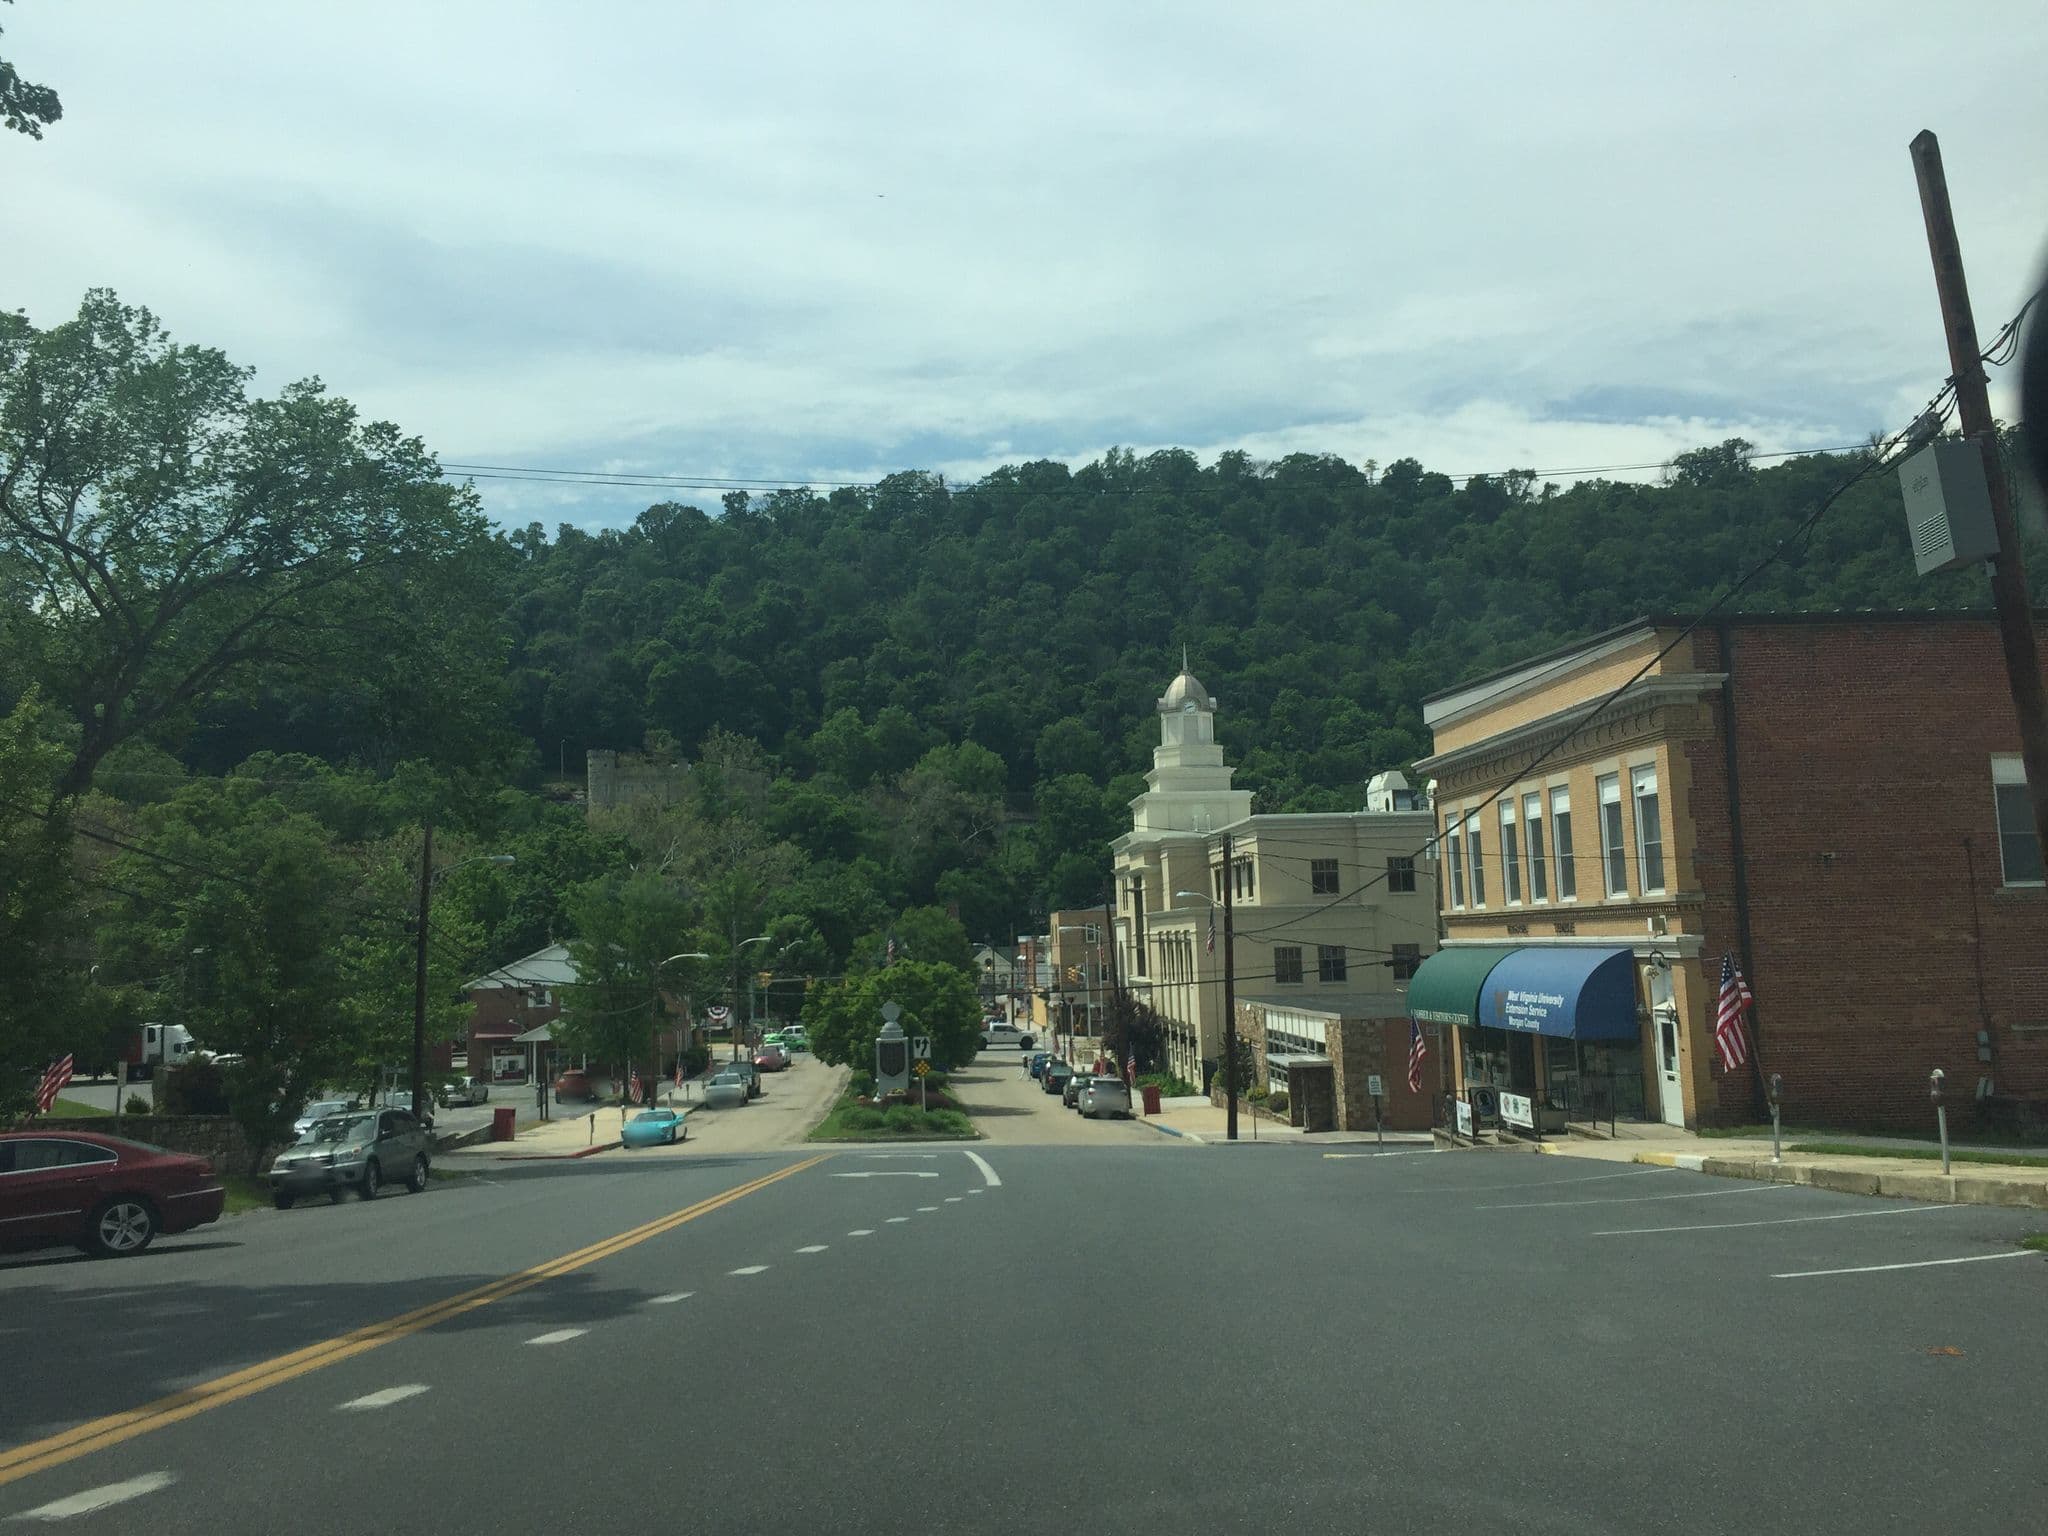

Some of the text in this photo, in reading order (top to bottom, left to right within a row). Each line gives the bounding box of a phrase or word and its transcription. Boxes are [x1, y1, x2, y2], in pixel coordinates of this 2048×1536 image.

[1507, 990, 1565, 1008] West Virginia University
[1505, 1002, 1548, 1017] Extension Service
[1508, 1015, 1540, 1031] Morgan County
